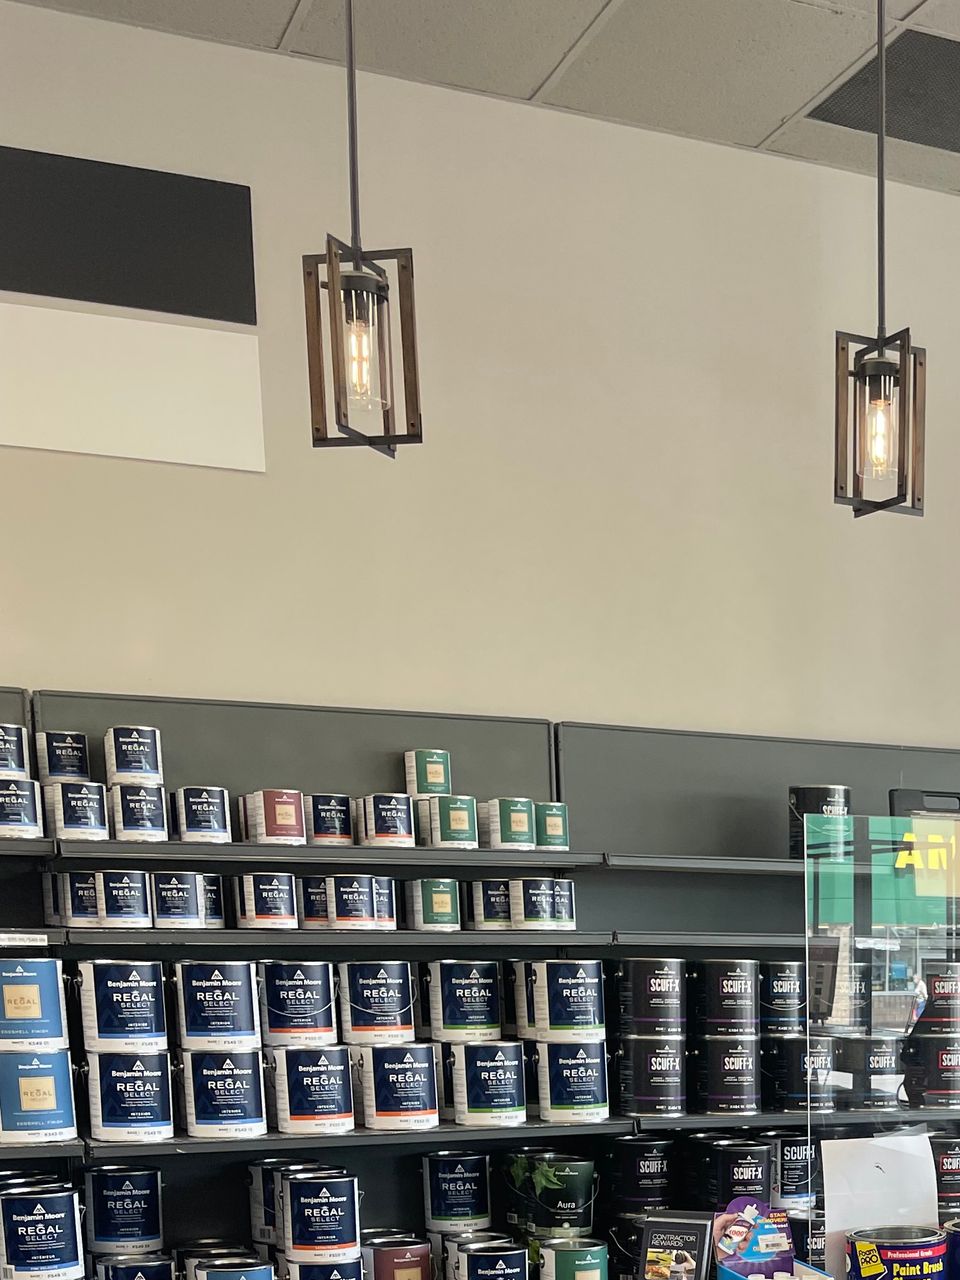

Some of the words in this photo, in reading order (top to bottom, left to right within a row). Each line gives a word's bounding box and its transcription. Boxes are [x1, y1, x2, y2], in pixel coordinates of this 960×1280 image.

[107, 980, 139, 988] Benjamin
[192, 980, 220, 988] Benjamin
[650, 979, 680, 993] SCUFF-X
[722, 979, 752, 993] SCUFF-X
[773, 981, 800, 993] SCUFF-X
[113, 992, 155, 1002] REGAL
[197, 991, 240, 1001] REGAL
[280, 990, 320, 999] REGAL
[363, 989, 401, 997] REGAL
[456, 989, 492, 997] REGAL
[563, 988, 598, 997] REGAL
[651, 1056, 680, 1071] SCUFF-X
[724, 1056, 753, 1070] SCUFF-X
[804, 1055, 831, 1069] SCUFF-X
[869, 1055, 896, 1069] SCUFF-X
[481, 1071, 517, 1080] REGAL
[563, 1068, 598, 1077] REGAL
[304, 1076, 342, 1085] REGAL
[389, 1073, 428, 1082] REGAL
[117, 1082, 159, 1091] REGAL
[208, 1080, 250, 1089] REGAL
[783, 1145, 815, 1161] SCUFF-X
[639, 1161, 667, 1174] SCUFF-X
[733, 1166, 763, 1180] SCUFF-X
[442, 1182, 478, 1190] REGAL
[301, 1196, 329, 1204] Benjamin
[557, 1200, 576, 1209] Aura
[107, 1201, 147, 1209] REGAL
[13, 1213, 44, 1221] Benjamin
[304, 1208, 344, 1217] REGAL
[18, 1225, 63, 1234] REGAL
[652, 1233, 696, 1242] CONTRACTOR
[861, 1255, 879, 1266] PRO
[893, 1263, 920, 1276] Paint
[923, 1258, 944, 1274] Brush
